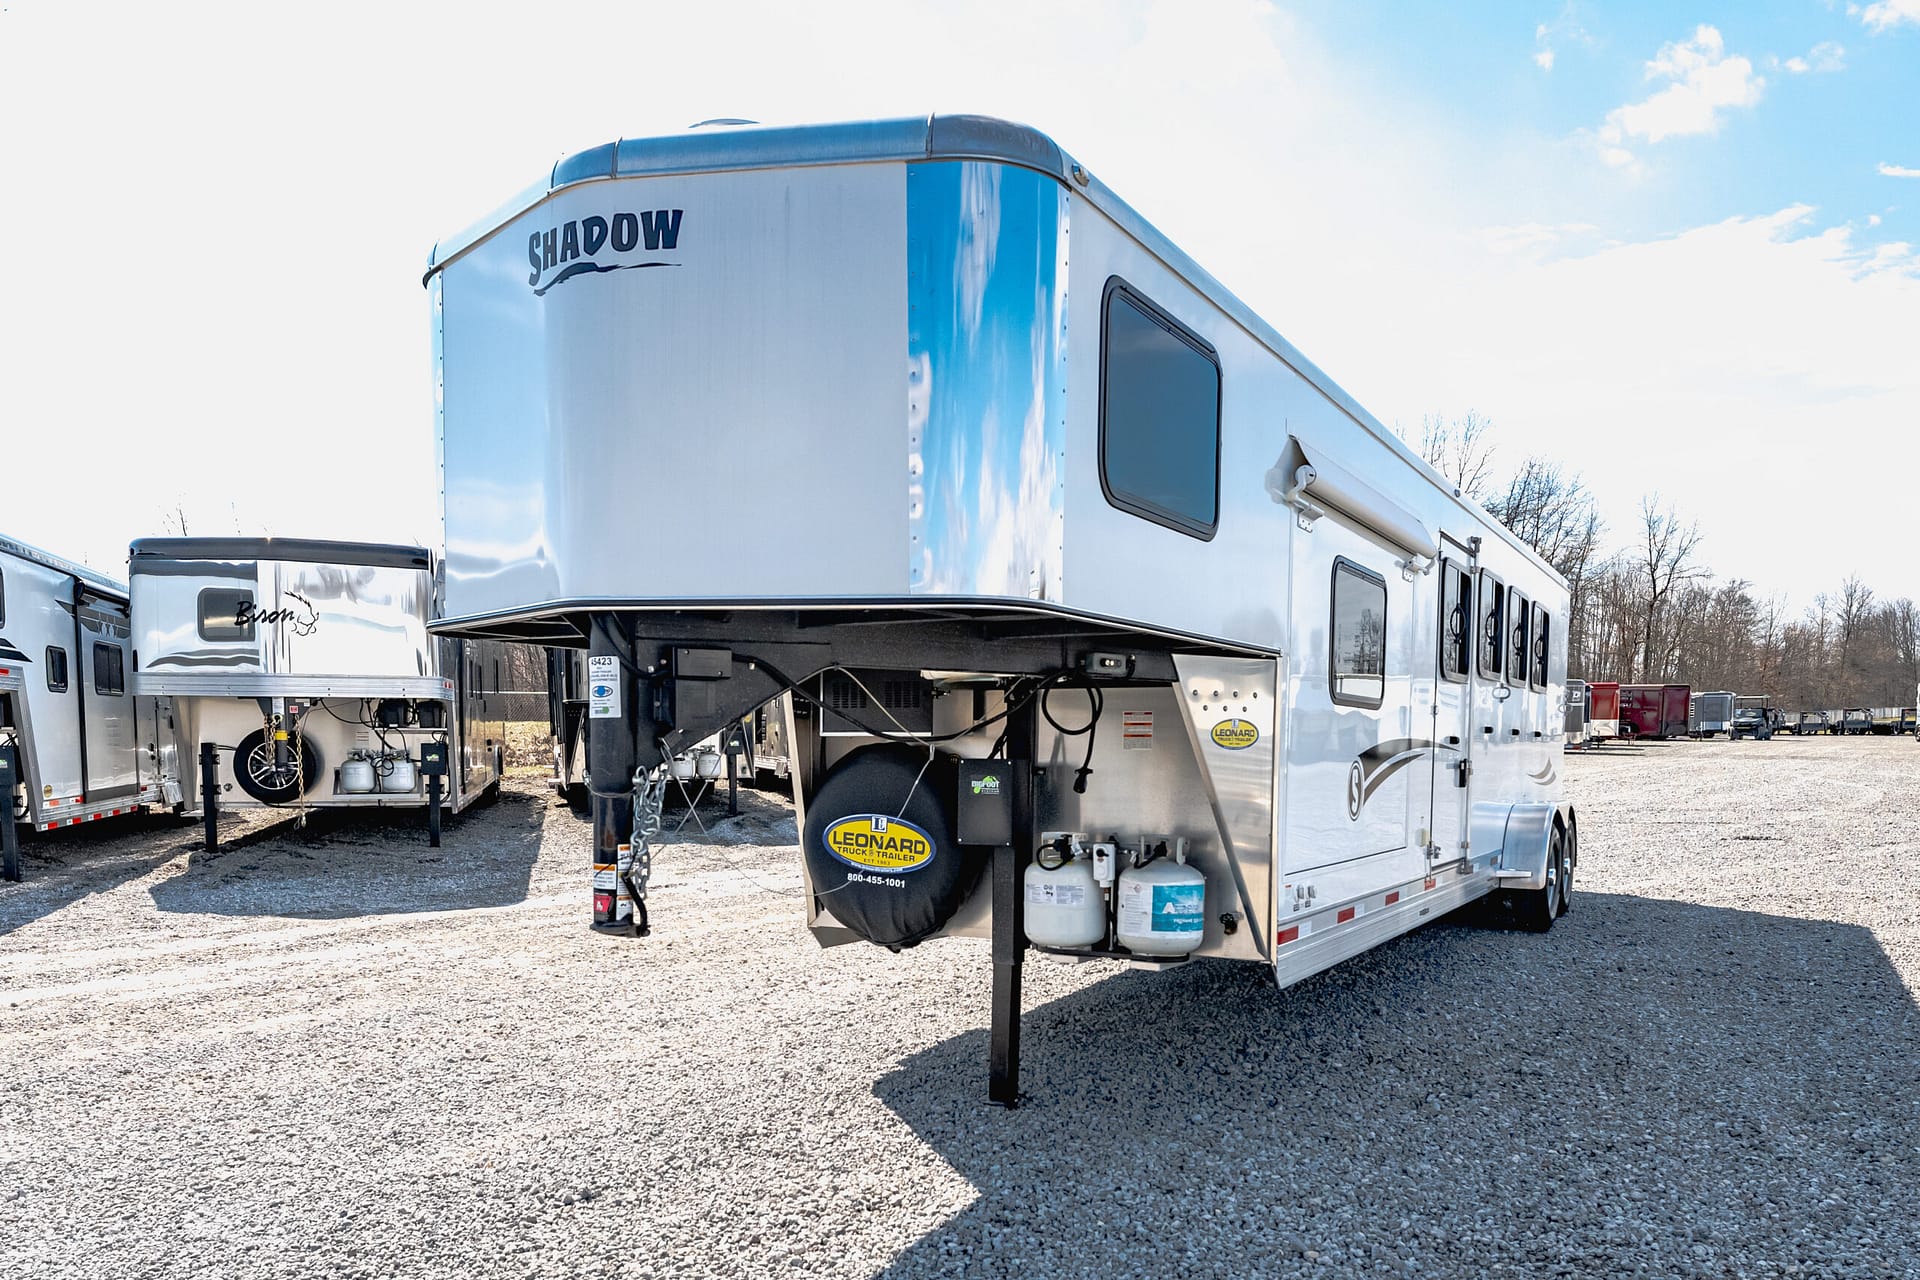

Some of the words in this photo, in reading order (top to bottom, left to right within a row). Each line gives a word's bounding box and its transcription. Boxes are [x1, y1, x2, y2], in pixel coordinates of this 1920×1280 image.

[528, 209, 683, 286] SHADOW
[234, 601, 295, 626] Bison
[1215, 728, 1255, 737] LEONARD
[833, 831, 926, 855] LEONARD
[837, 846, 867, 856] TRUCK
[876, 851, 915, 862] TRAILER
[847, 872, 906, 888] 800-455-1001
